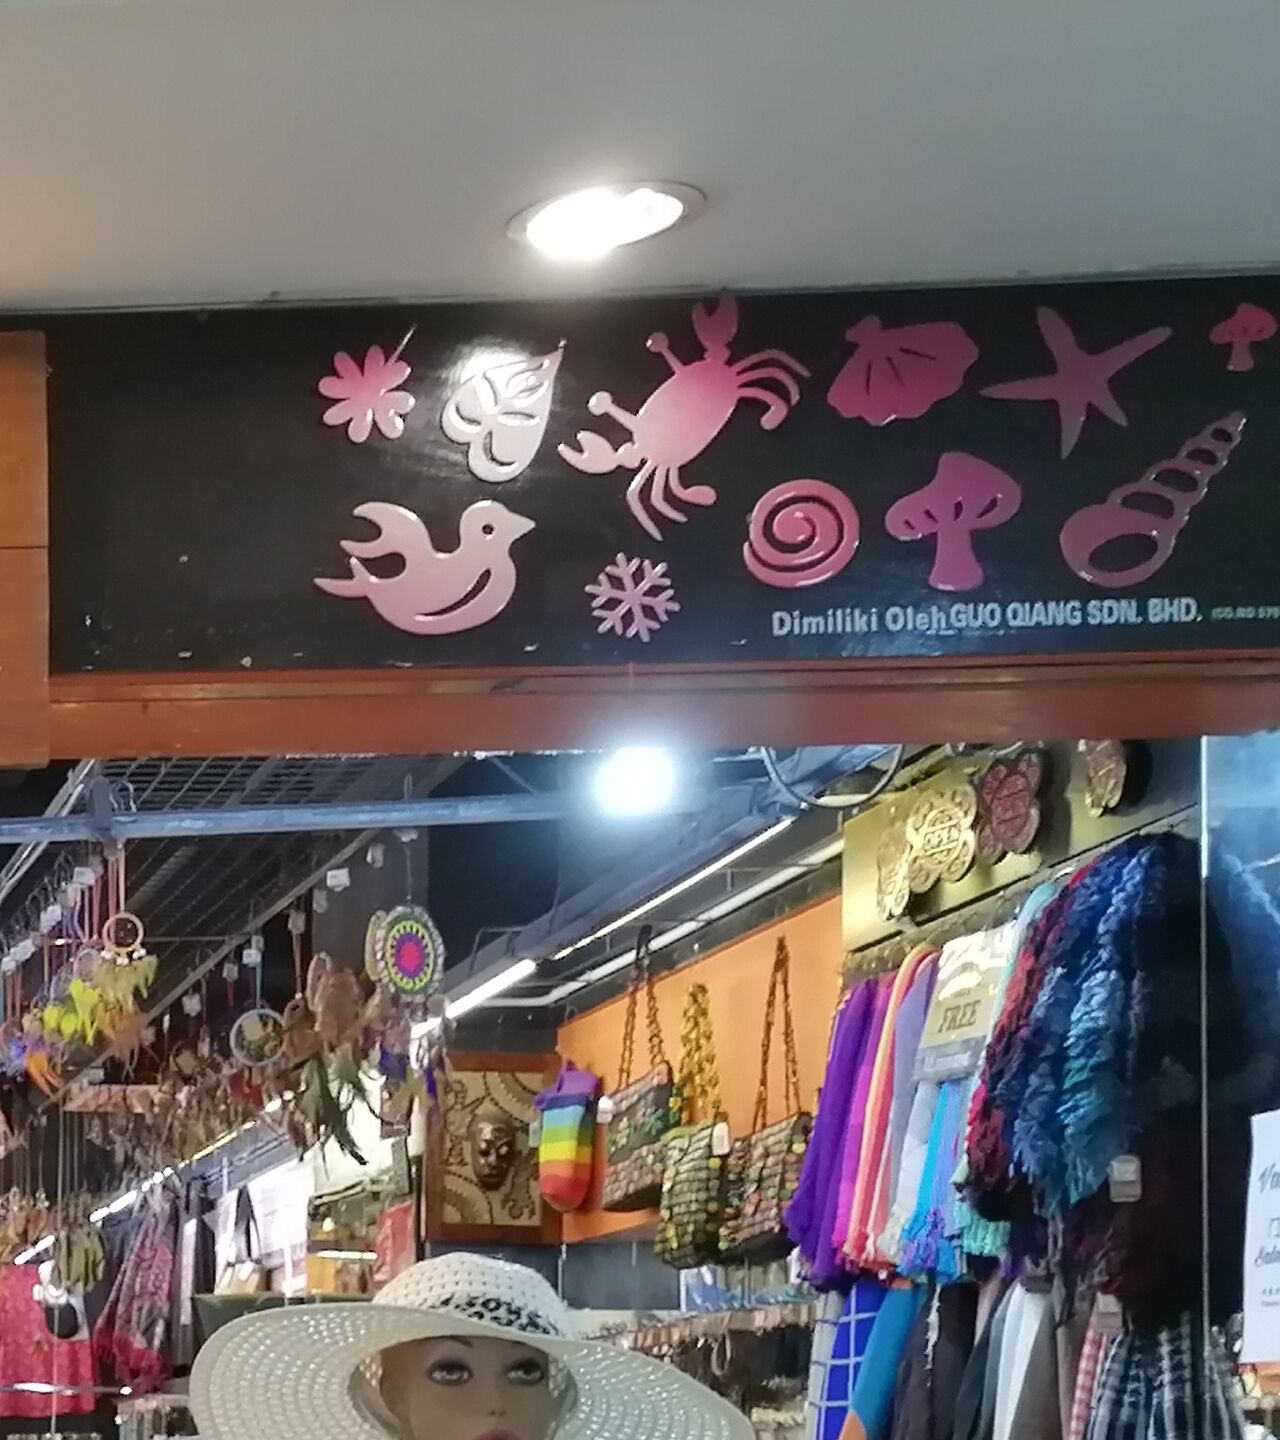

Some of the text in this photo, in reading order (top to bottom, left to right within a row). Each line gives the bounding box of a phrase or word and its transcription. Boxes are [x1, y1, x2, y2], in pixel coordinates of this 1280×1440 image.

[772, 608, 878, 636] Dimiliki
[885, 605, 948, 632] Oleh
[950, 602, 1001, 628] GUO
[1006, 600, 1083, 627] QIANG
[1087, 598, 1143, 625] SDN.
[1147, 597, 1203, 622] BHD.
[938, 1000, 982, 1033] FREE
